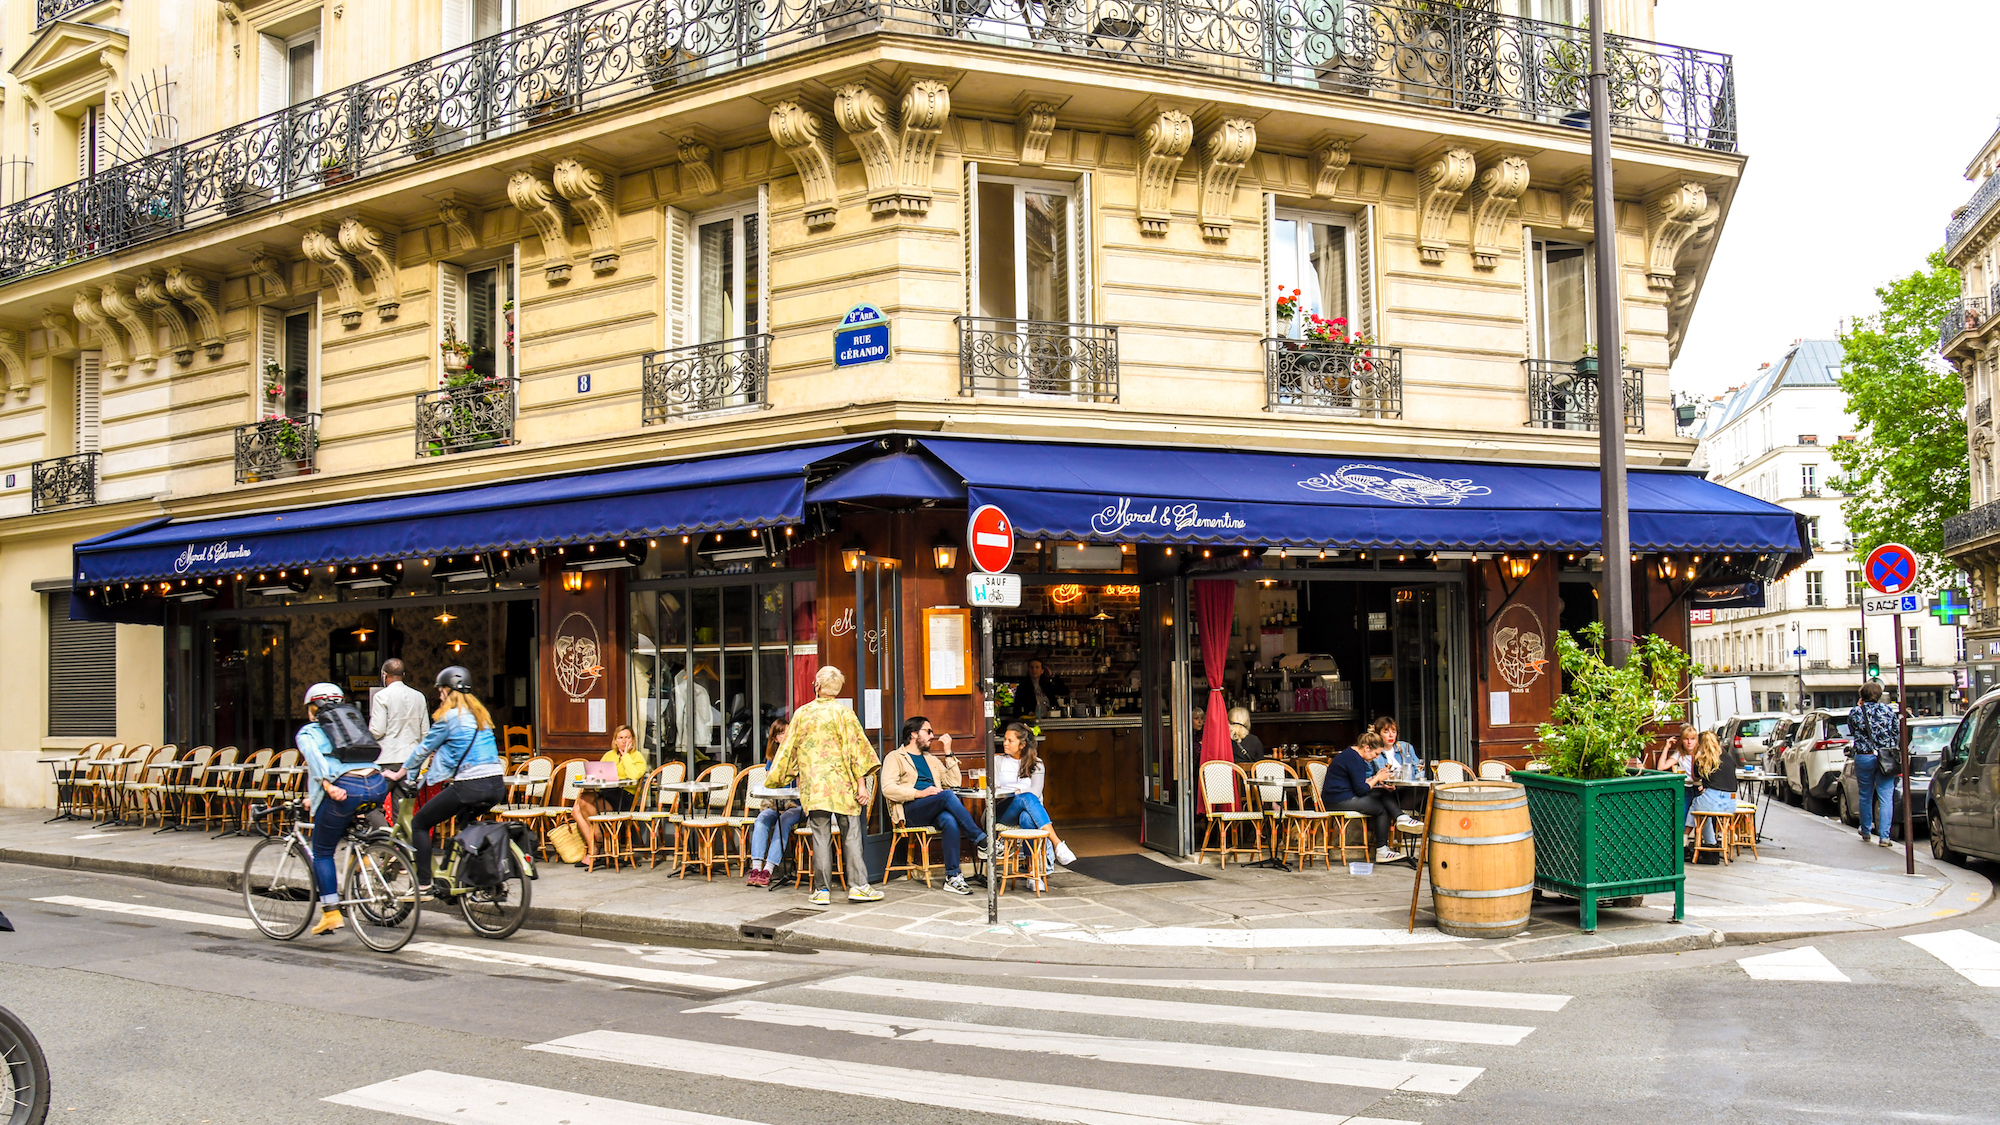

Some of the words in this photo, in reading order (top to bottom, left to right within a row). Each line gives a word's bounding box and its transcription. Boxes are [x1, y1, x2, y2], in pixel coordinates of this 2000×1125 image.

[853, 334, 872, 346] RUE
[840, 345, 884, 361] GÉRANDO
[580, 375, 588, 392] 8
[7, 475, 14, 488] 10
[1091, 497, 1157, 535] Marcel
[1160, 506, 1171, 526] &
[1172, 503, 1246, 531] Clementine
[985, 577, 1006, 586] SAUF
